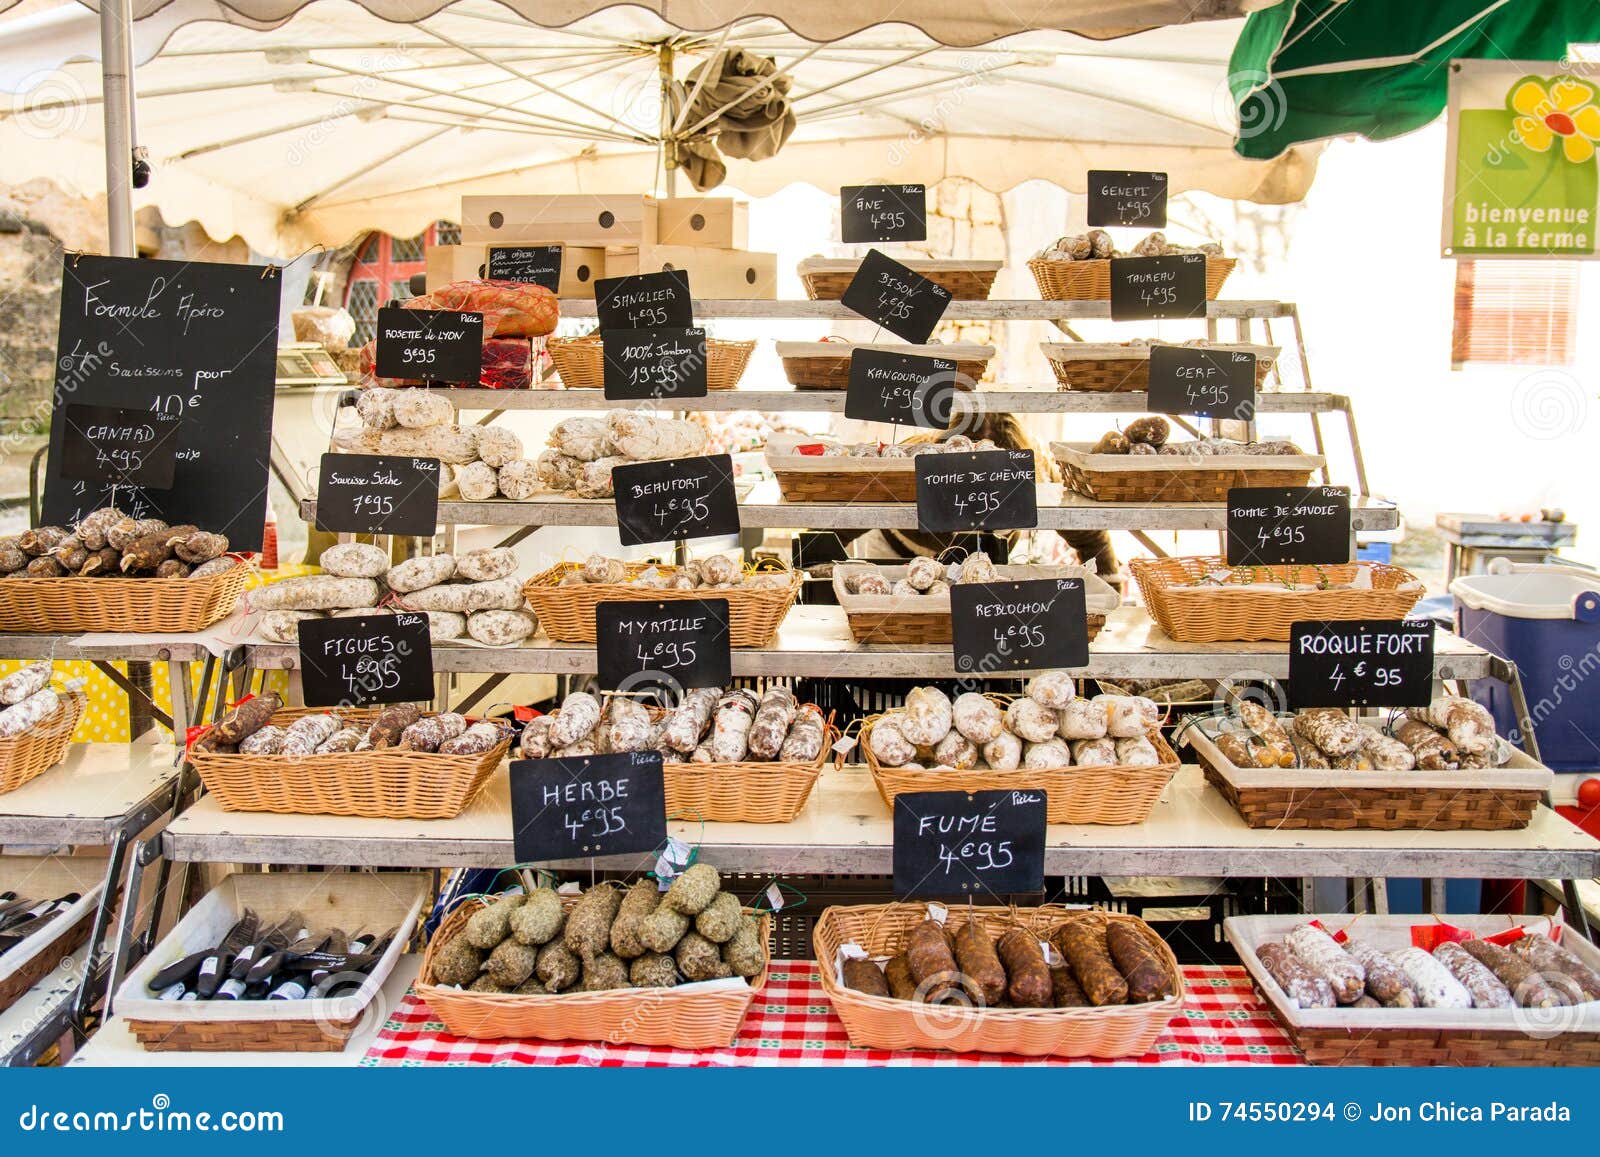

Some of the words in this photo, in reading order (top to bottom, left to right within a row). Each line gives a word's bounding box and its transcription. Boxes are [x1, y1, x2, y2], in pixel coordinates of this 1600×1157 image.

[871, 211, 905, 230] 4€95
[1465, 202, 1589, 224] bienvenue
[1463, 227, 1477, 247] à
[1486, 227, 1508, 247] la
[1515, 226, 1588, 247] ferme
[878, 272, 923, 297] BISON
[1126, 271, 1176, 284] TAUREAU
[85, 276, 165, 318] Formule
[612, 287, 676, 309] SANGLIER
[878, 290, 915, 319] 4€95
[1140, 286, 1177, 307] 4€95
[629, 306, 669, 329] 4€95
[385, 329, 422, 340] ROSETTE
[425, 328, 437, 340] de
[438, 330, 466, 340] LYON
[402, 348, 436, 364] 9€95
[620, 342, 654, 362] 100%
[655, 340, 692, 357] Jambon
[194, 369, 232, 390] pour
[867, 367, 931, 384] KANGOUROU
[1175, 366, 1216, 379] CERF
[880, 386, 924, 410] 4€95
[1186, 384, 1230, 406] 4€95
[87, 424, 155, 443] CANARD
[96, 449, 142, 471] 4€95
[631, 475, 709, 499] BEAUFORT
[968, 471, 987, 484] DE
[353, 494, 393, 515] 7€95
[654, 494, 710, 527] 4€95
[954, 490, 1000, 516] 4€95
[1272, 505, 1290, 518] DE
[1292, 504, 1339, 517] SAVOIE
[1257, 525, 1305, 549] 4€95
[975, 599, 1055, 617] REBLOCHON
[618, 616, 706, 635] MYRTILLE
[993, 624, 1045, 649] 4€95
[323, 634, 395, 657] FIGUES
[636, 640, 697, 671] 4€95
[341, 659, 401, 693] 4€95
[543, 778, 630, 806] HERBE
[564, 806, 626, 840] 4€95
[919, 802, 997, 836] FUMÉ
[939, 841, 1013, 874] 4€95
